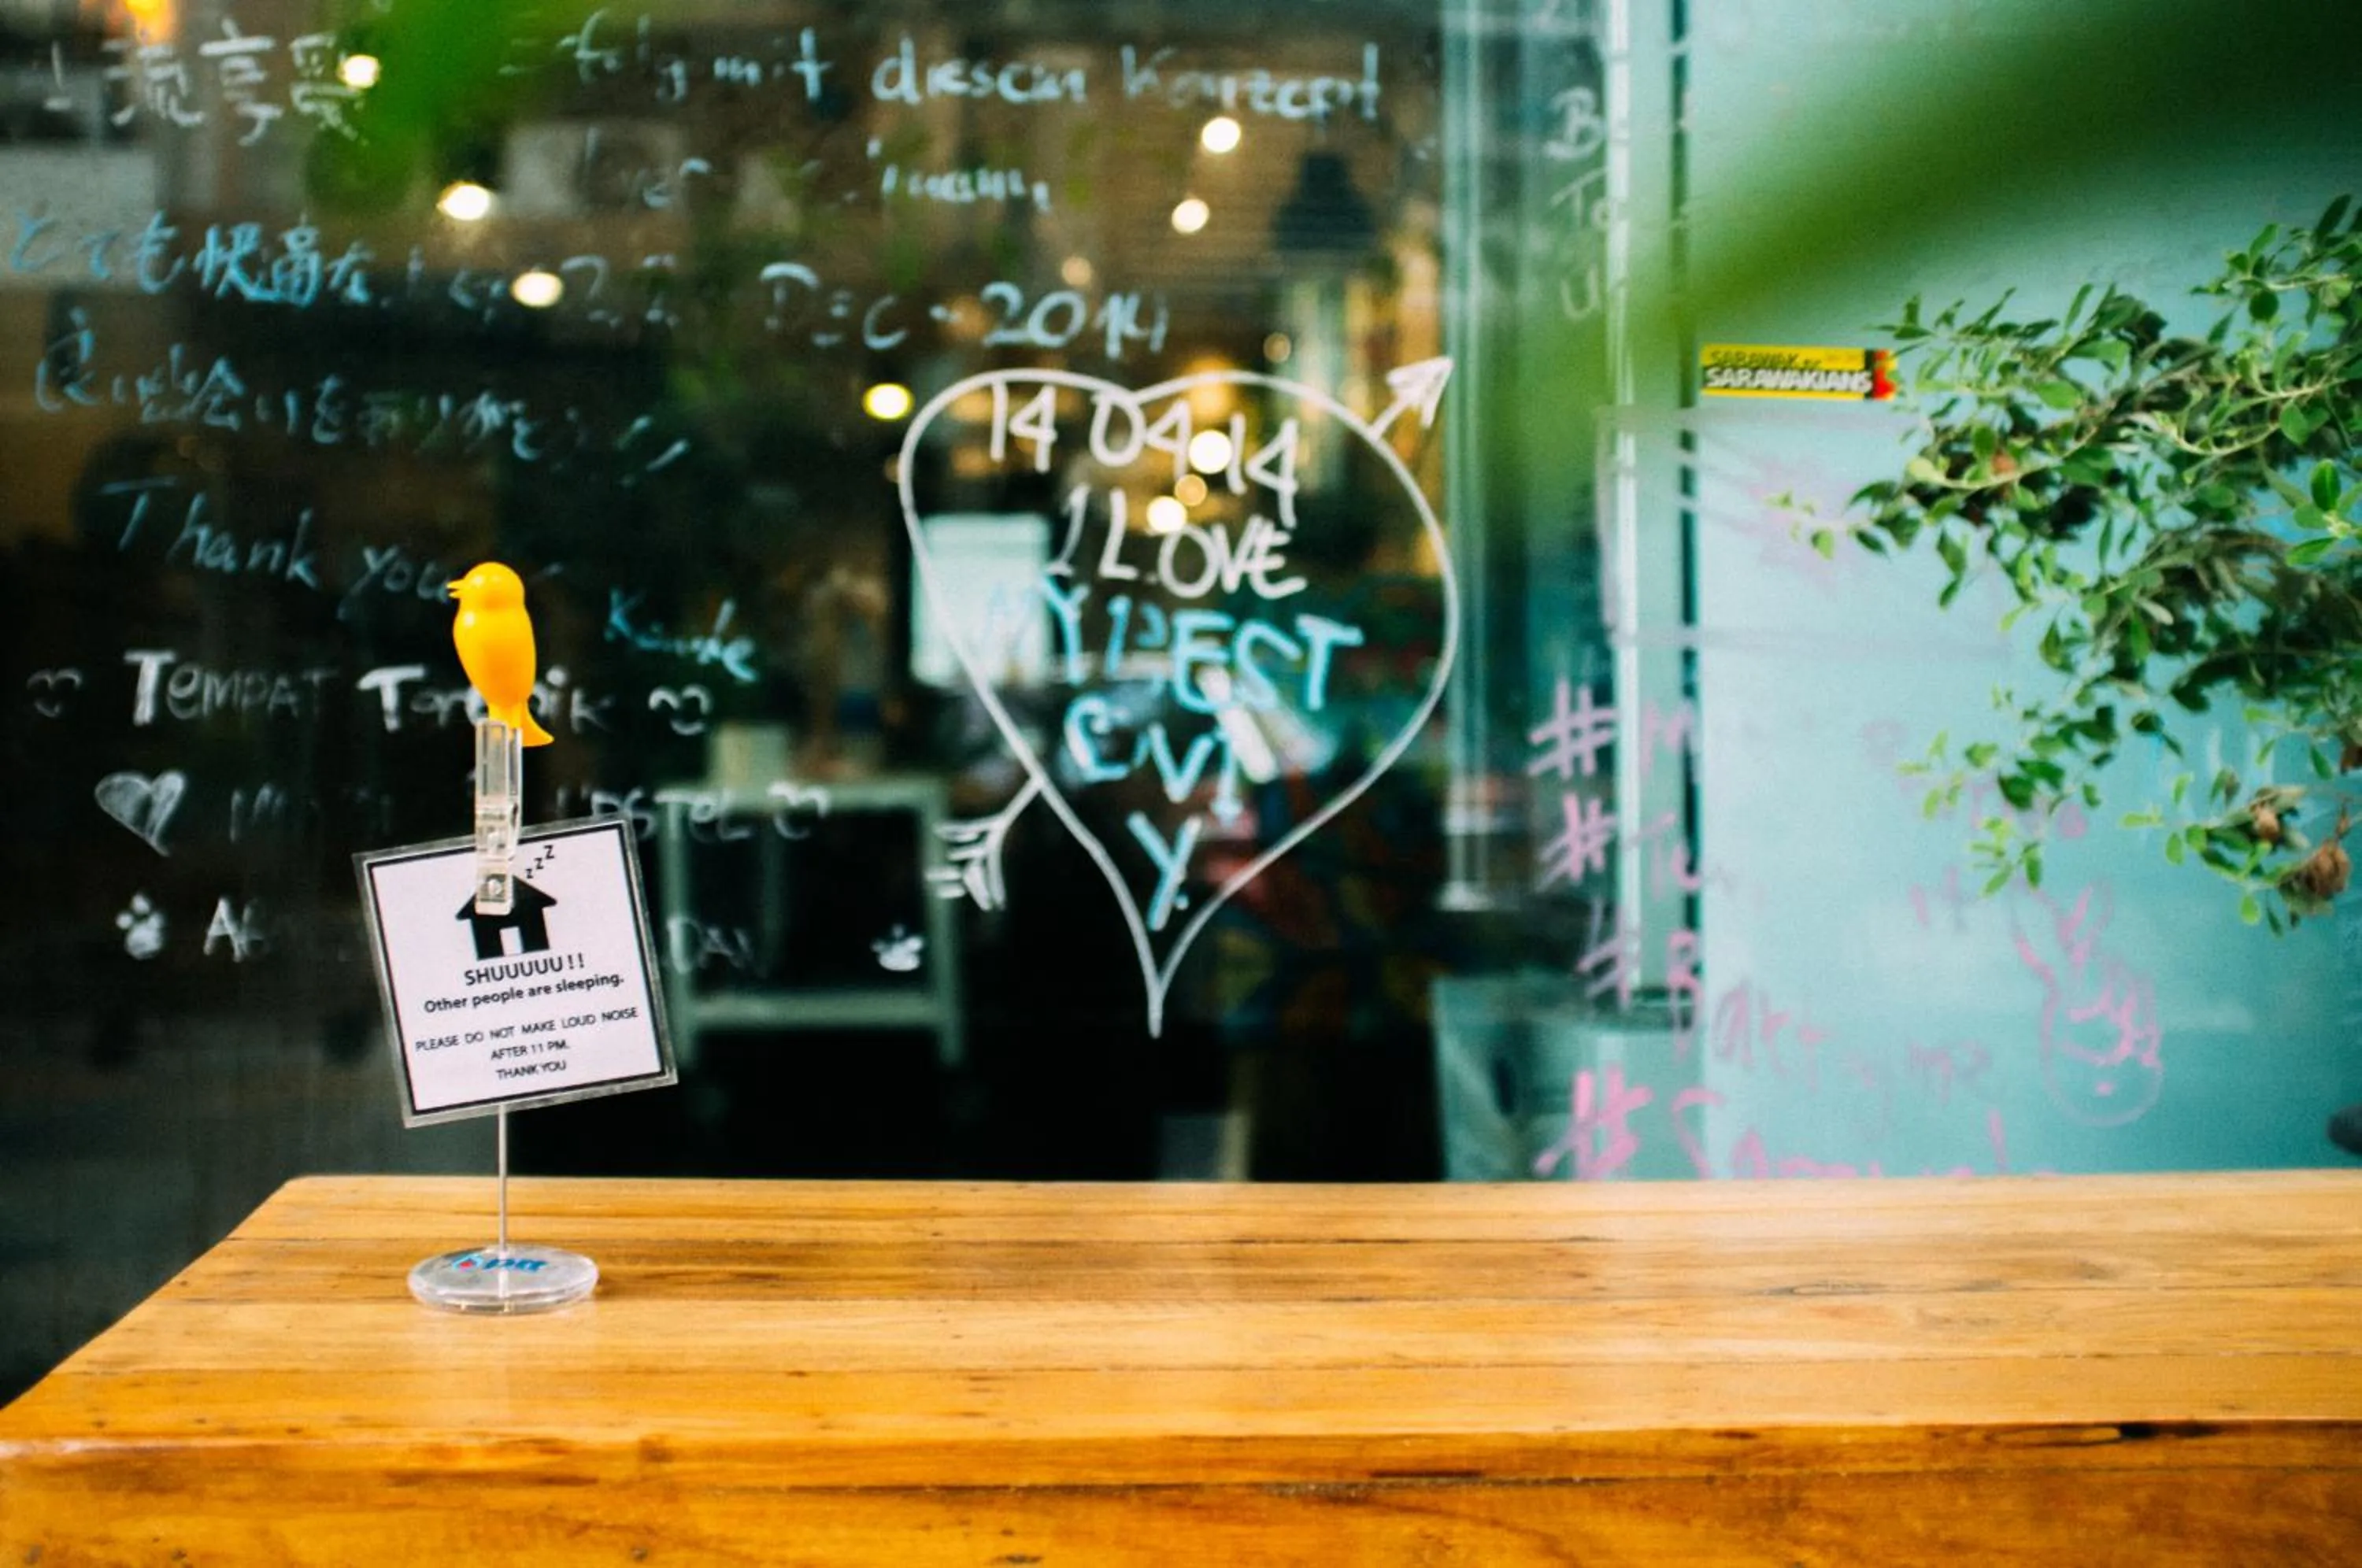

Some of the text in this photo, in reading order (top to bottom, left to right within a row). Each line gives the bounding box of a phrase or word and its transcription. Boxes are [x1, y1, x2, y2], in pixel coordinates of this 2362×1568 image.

[1705, 367, 1872, 393] SARAWAKIANS
[989, 379, 1301, 529] 14 04 14
[99, 472, 318, 590] Thank
[1098, 489, 1308, 600] LOVE
[1105, 594, 1365, 712] BEST
[424, 974, 626, 1014] Other people are sleeping.
[415, 1007, 640, 1052] PLEASE DO NOT MAKE LOUD NOISE
[490, 1045, 528, 1061] AFTER
[531, 1043, 545, 1055] 11
[496, 1060, 568, 1081] THANK YOU
